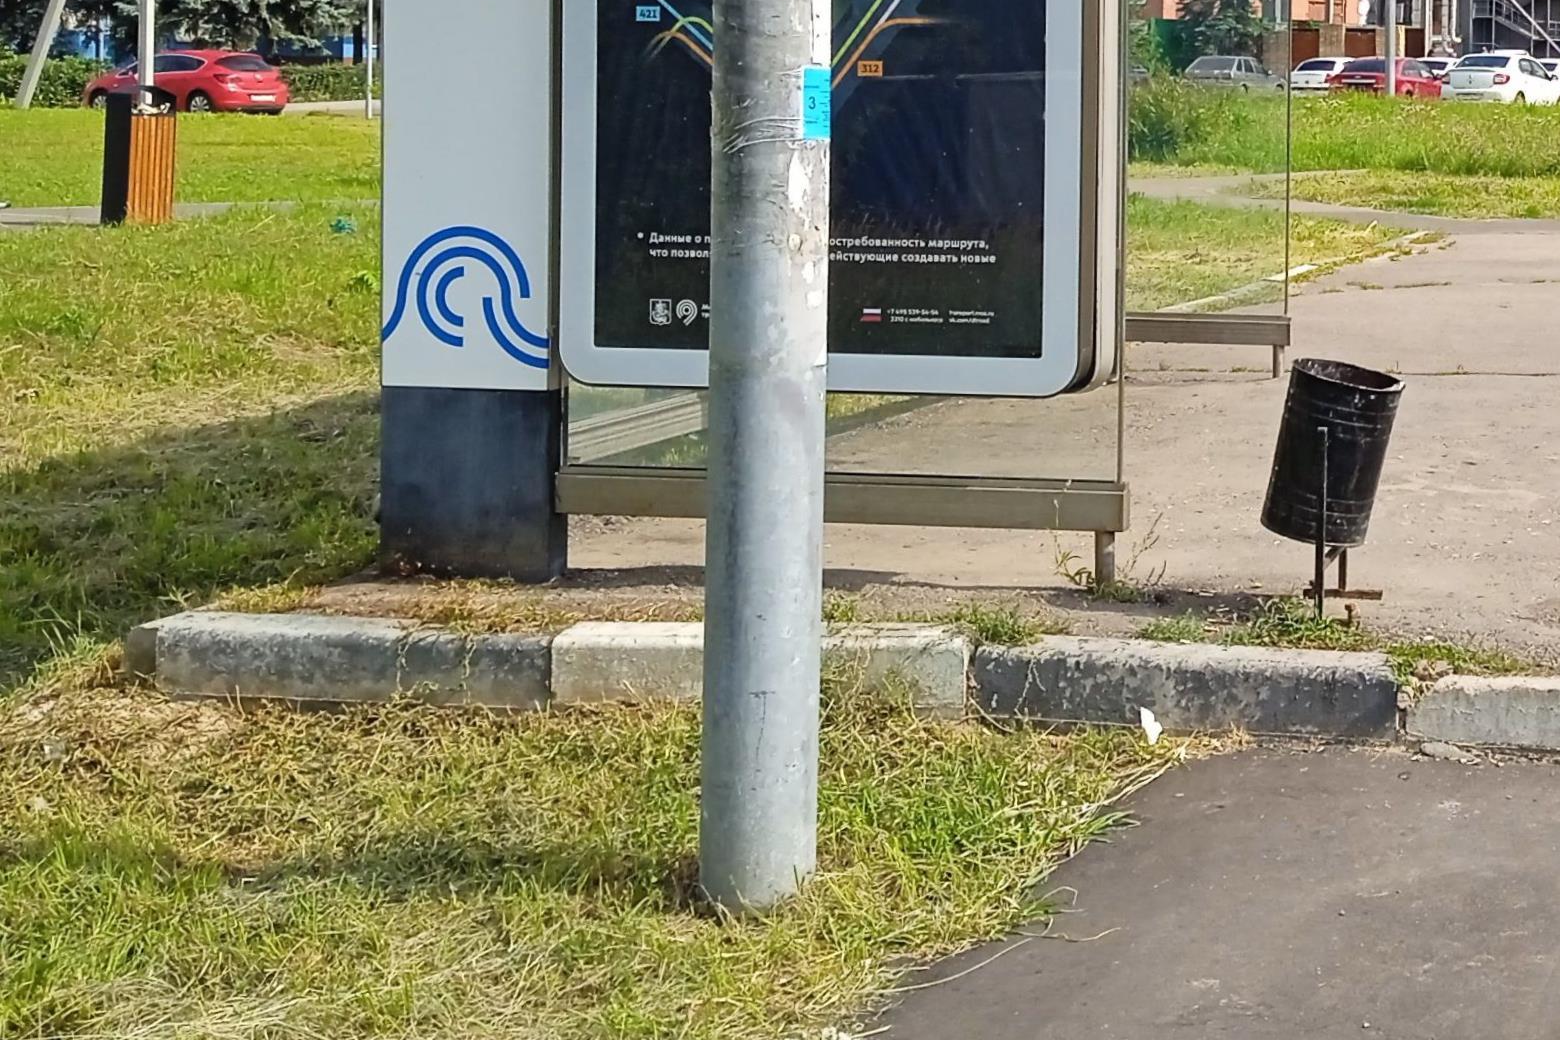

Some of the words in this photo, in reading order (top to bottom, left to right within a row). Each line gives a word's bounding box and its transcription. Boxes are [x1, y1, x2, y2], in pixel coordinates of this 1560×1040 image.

[639, 8, 657, 19] 421
[860, 64, 880, 73] 312
[808, 96, 816, 110] 3
[649, 232, 692, 244] Данные
[829, 236, 926, 249] остребованность
[928, 239, 989, 251] маршрута,
[649, 248, 669, 257] что
[670, 249, 711, 258] позвол
[829, 250, 899, 264] ействующие
[901, 252, 958, 263] создавать
[960, 254, 996, 263] новые
